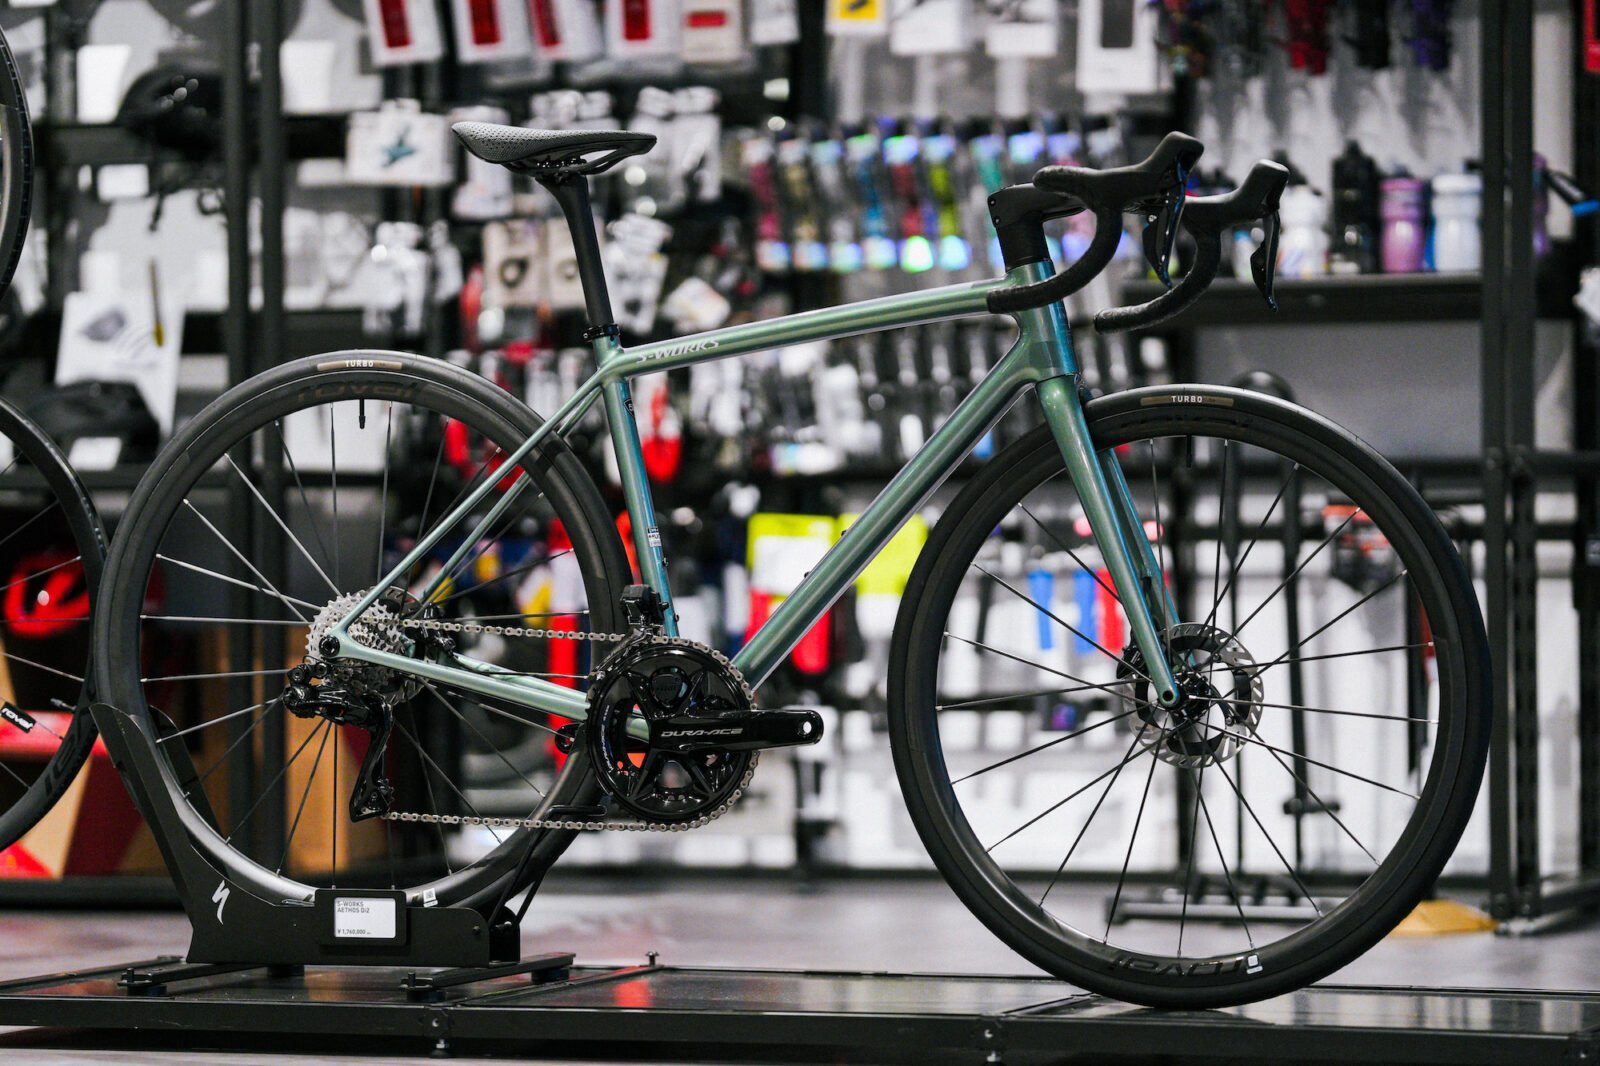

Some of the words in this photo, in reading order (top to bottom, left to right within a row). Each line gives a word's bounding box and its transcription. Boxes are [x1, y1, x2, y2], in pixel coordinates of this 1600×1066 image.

[636, 339, 720, 364] S-WORKS
[345, 359, 374, 368] TURBO
[1171, 395, 1203, 403] TURBO
[1, 707, 34, 731] roval
[661, 727, 744, 737] DURA-ACE
